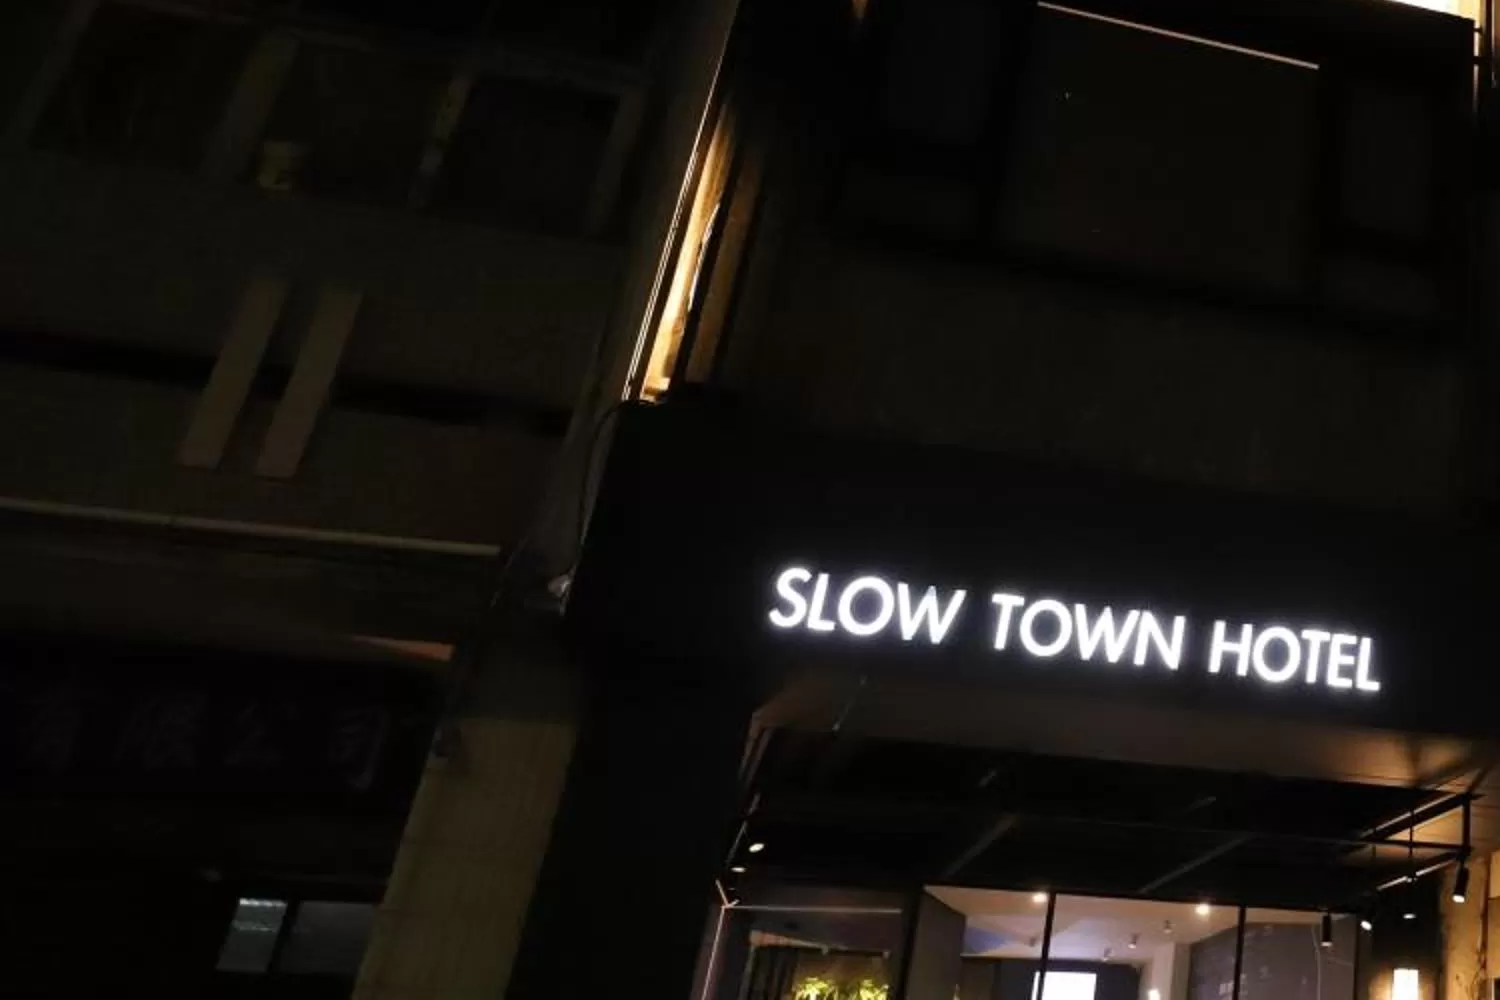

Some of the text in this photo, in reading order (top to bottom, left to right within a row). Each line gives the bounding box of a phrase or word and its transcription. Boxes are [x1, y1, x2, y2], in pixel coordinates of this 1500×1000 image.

[768, 566, 1381, 693] SLOW TOWN HOTEL
